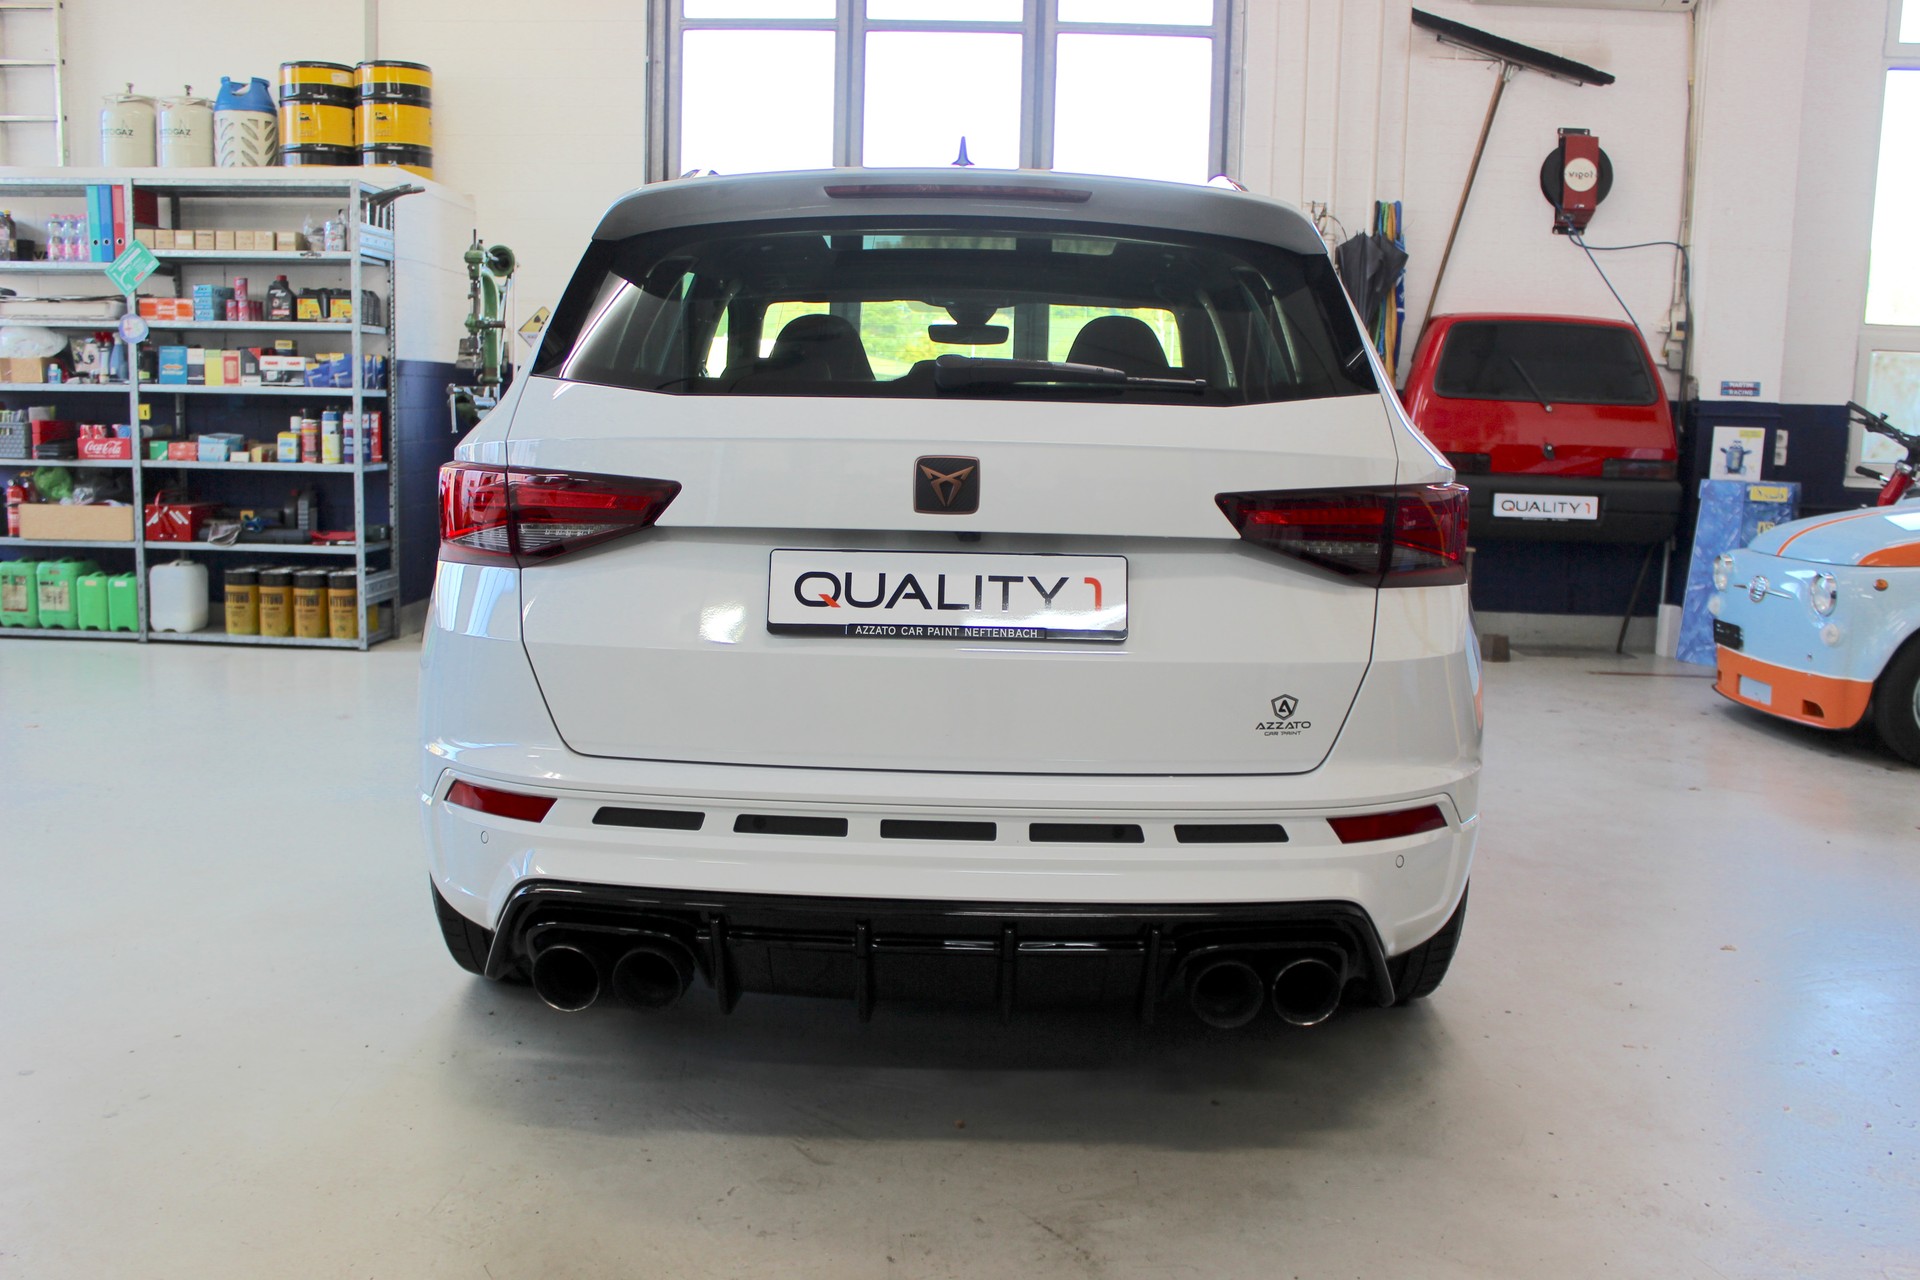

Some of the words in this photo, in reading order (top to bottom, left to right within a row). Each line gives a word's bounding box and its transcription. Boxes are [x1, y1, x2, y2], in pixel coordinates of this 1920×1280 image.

[1501, 499, 1582, 514] QUALITY
[1585, 502, 1591, 514] 1
[794, 571, 1070, 613] QUALITY
[1084, 576, 1103, 612] 1
[855, 625, 896, 635] AZZATO
[901, 626, 923, 636] CAR
[927, 626, 959, 637] PAINT
[964, 628, 1038, 638] NEFTENBACH
[1255, 721, 1311, 730] AZZATO
